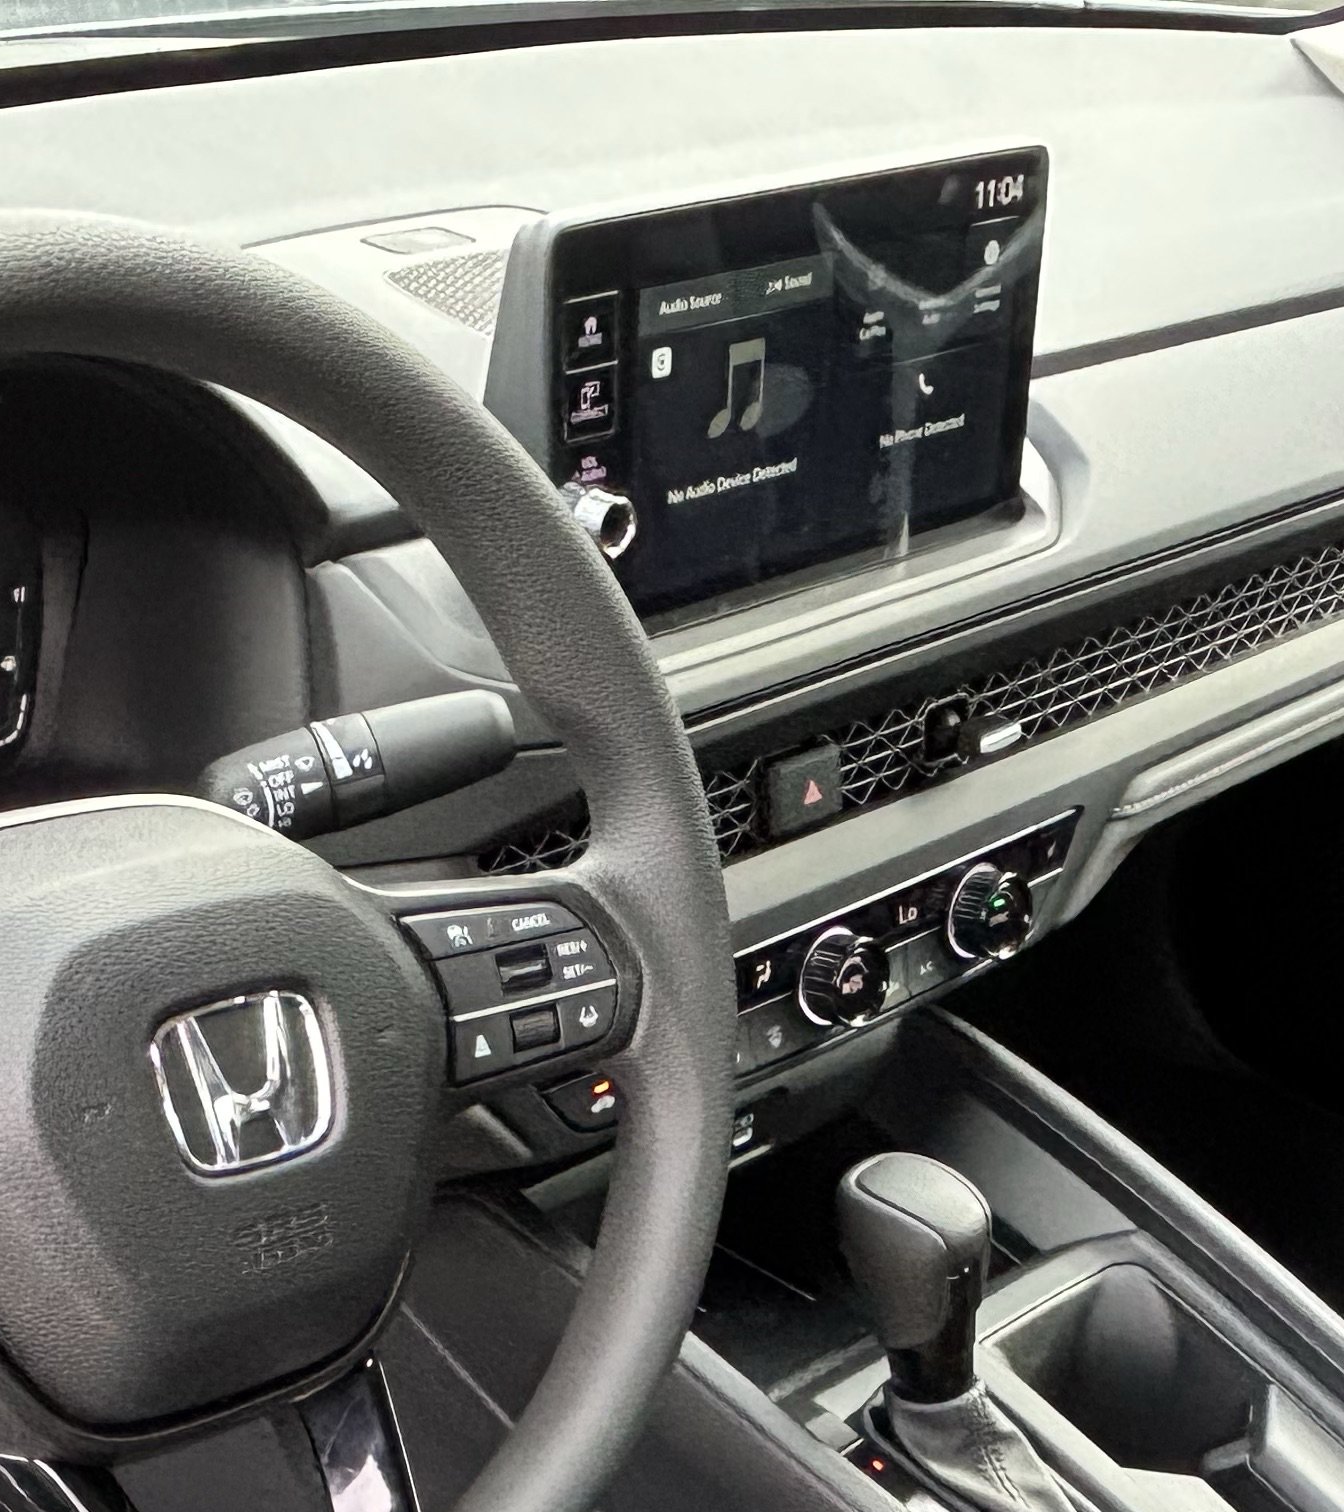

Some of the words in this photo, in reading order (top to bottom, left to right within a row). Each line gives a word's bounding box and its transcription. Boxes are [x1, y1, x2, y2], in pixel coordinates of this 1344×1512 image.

[975, 174, 1024, 209] 11:04
[659, 298, 688, 316] Audio
[690, 293, 723, 311] Source
[667, 490, 685, 505] No
[686, 480, 716, 500] Audio
[716, 473, 751, 494] Device
[752, 457, 798, 482] Detected
[268, 770, 295, 788] OFF
[277, 802, 295, 817] LO
